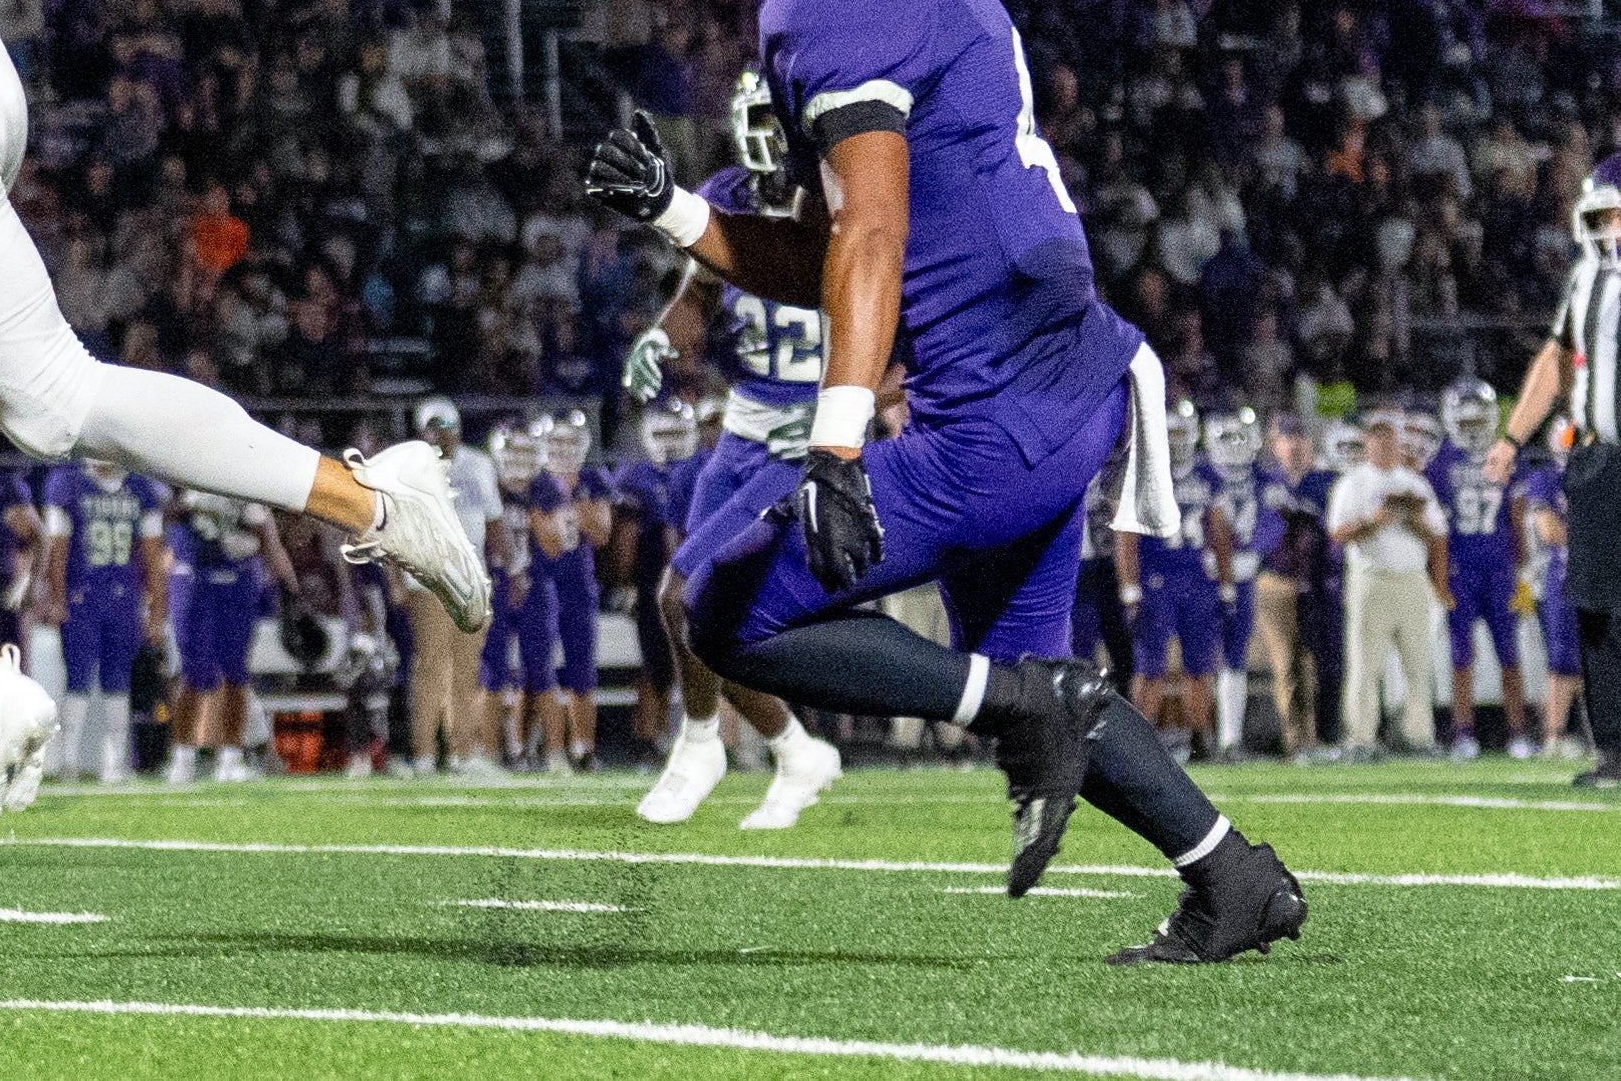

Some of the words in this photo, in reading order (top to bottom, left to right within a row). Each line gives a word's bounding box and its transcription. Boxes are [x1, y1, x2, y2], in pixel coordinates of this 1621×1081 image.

[734, 294, 821, 382] 22
[1456, 487, 1503, 535] 97
[86, 520, 133, 566] 99
